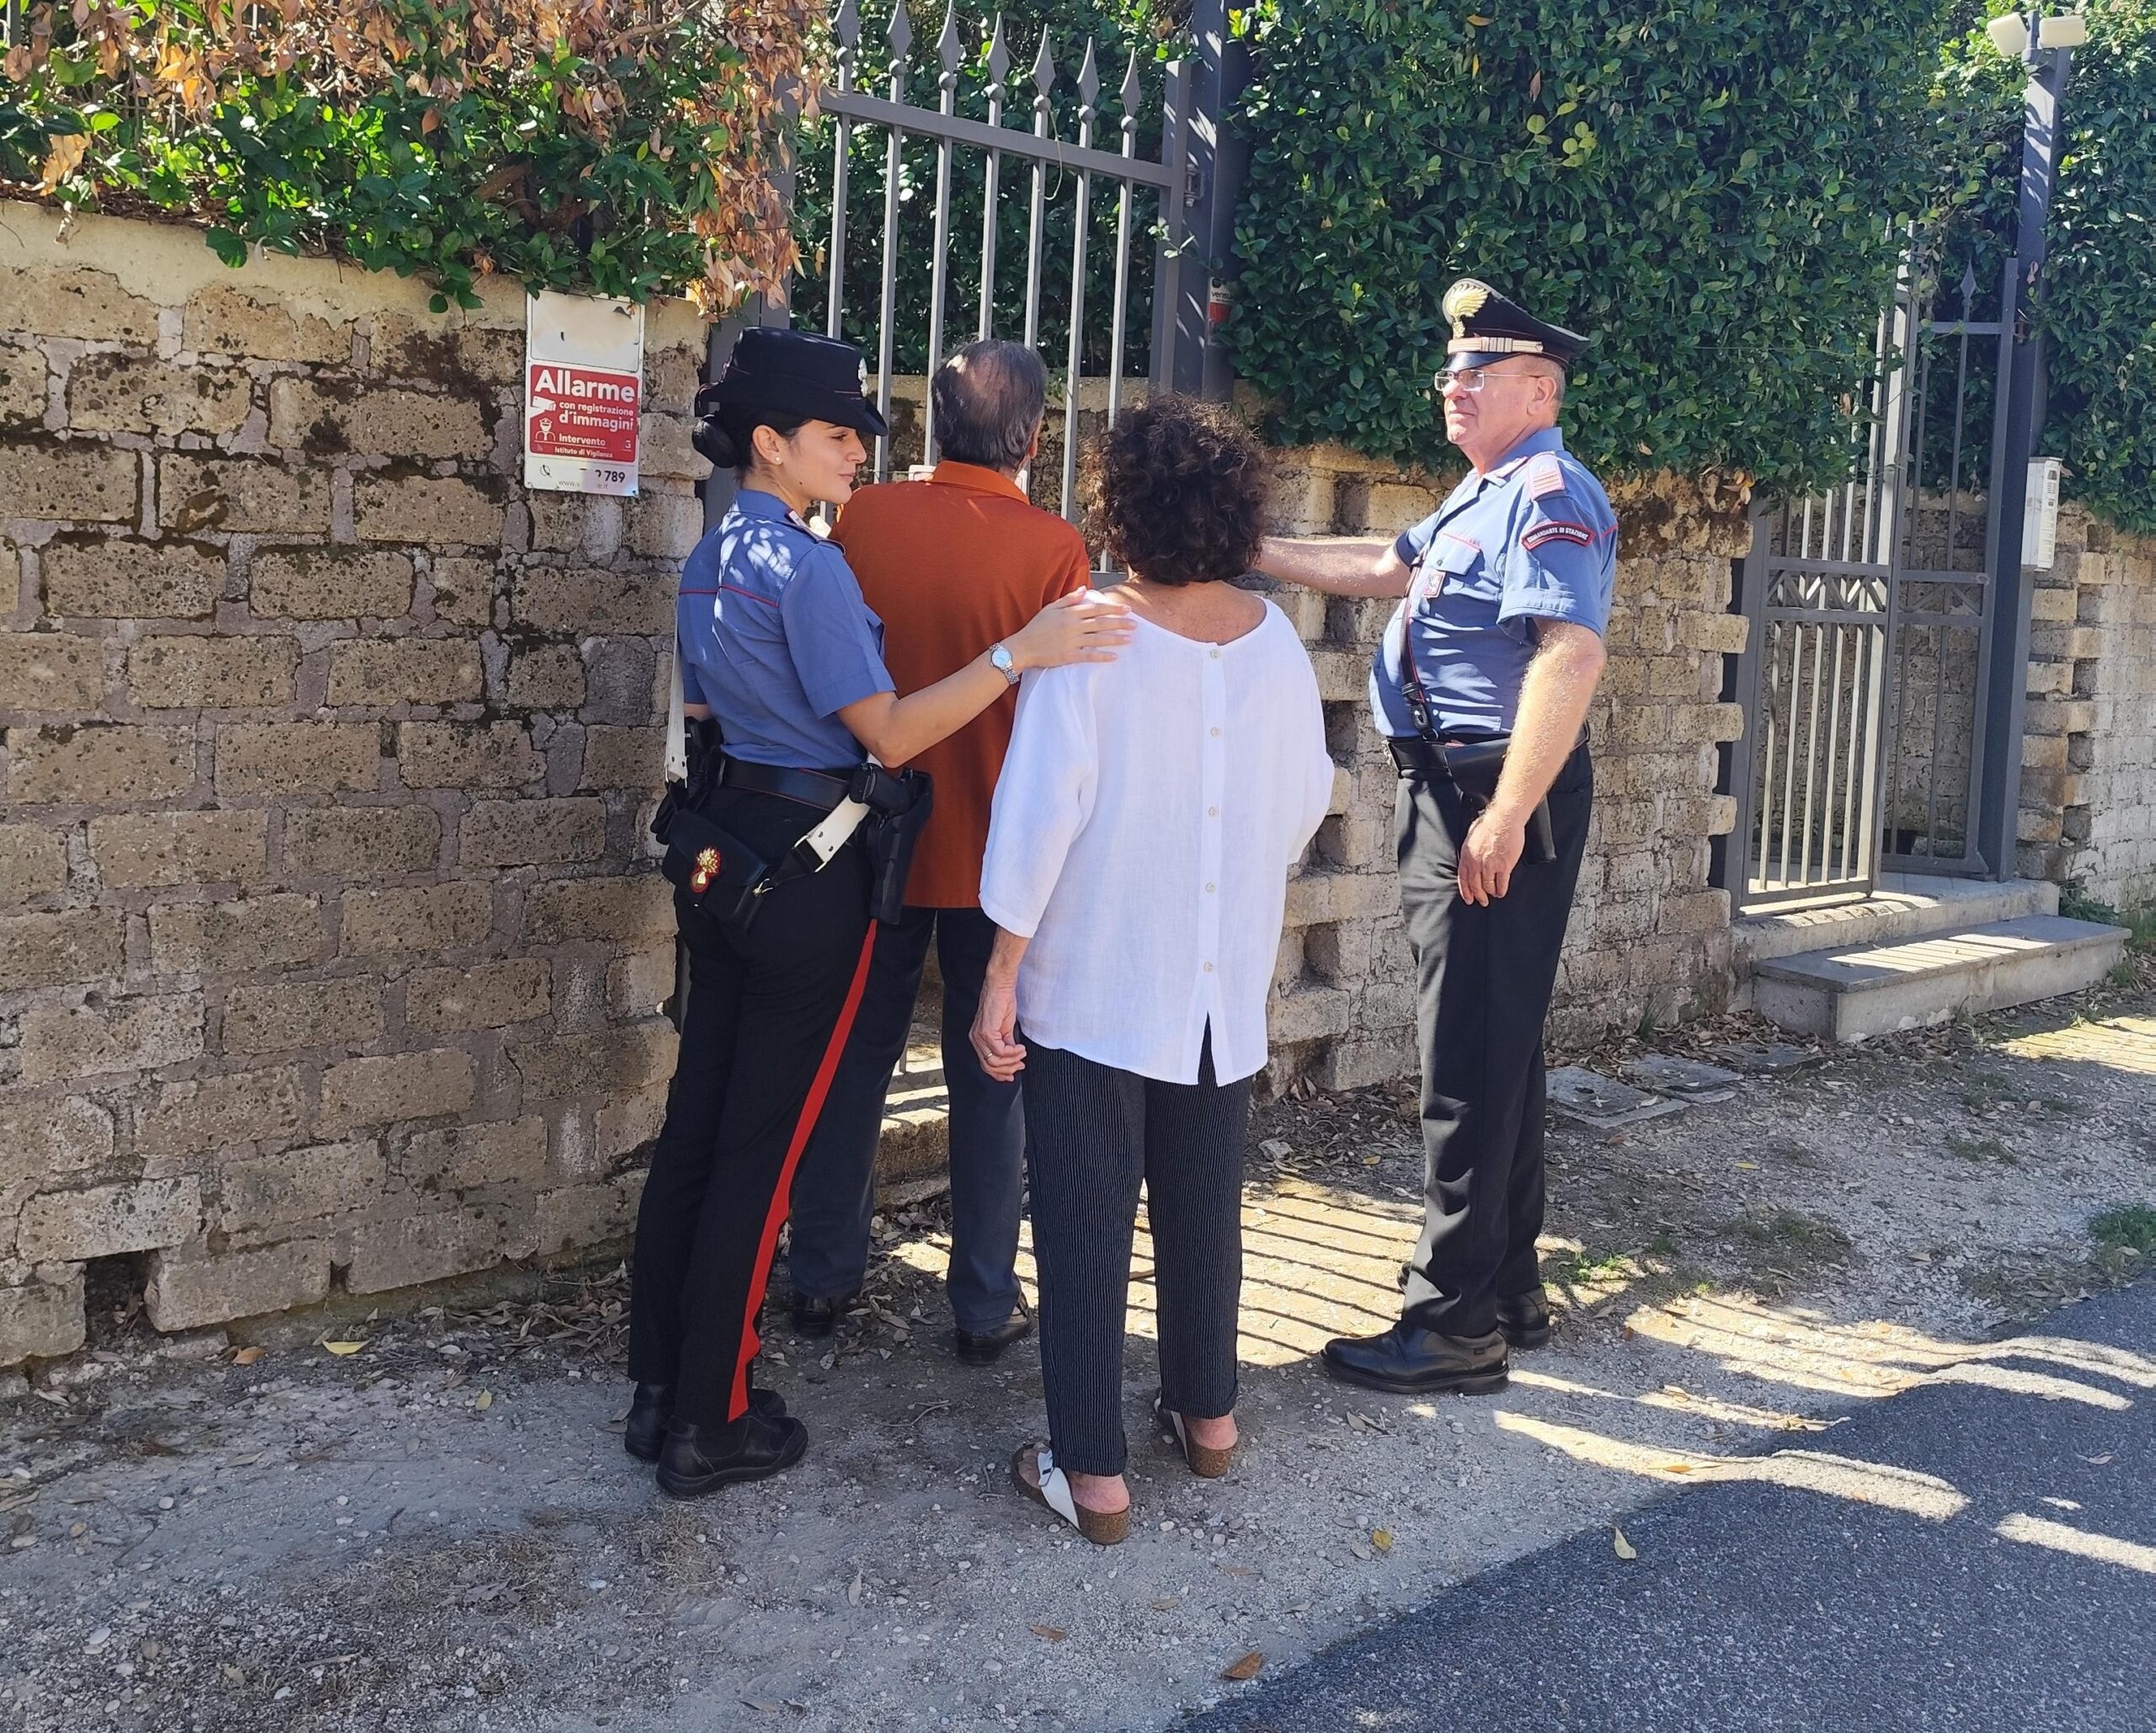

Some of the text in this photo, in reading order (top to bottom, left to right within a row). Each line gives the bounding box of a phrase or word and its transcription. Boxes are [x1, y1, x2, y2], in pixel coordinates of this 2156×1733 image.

[534, 369, 635, 403] Allarme
[558, 402, 634, 416] con registrazione
[558, 433, 606, 446] Intervento
[554, 446, 577, 455] Istituto
[586, 449, 613, 458] Vigilanza
[604, 470, 626, 483] 789
[1527, 527, 1558, 542] COMANDANTE
[1565, 527, 1588, 541] STAZIONE
